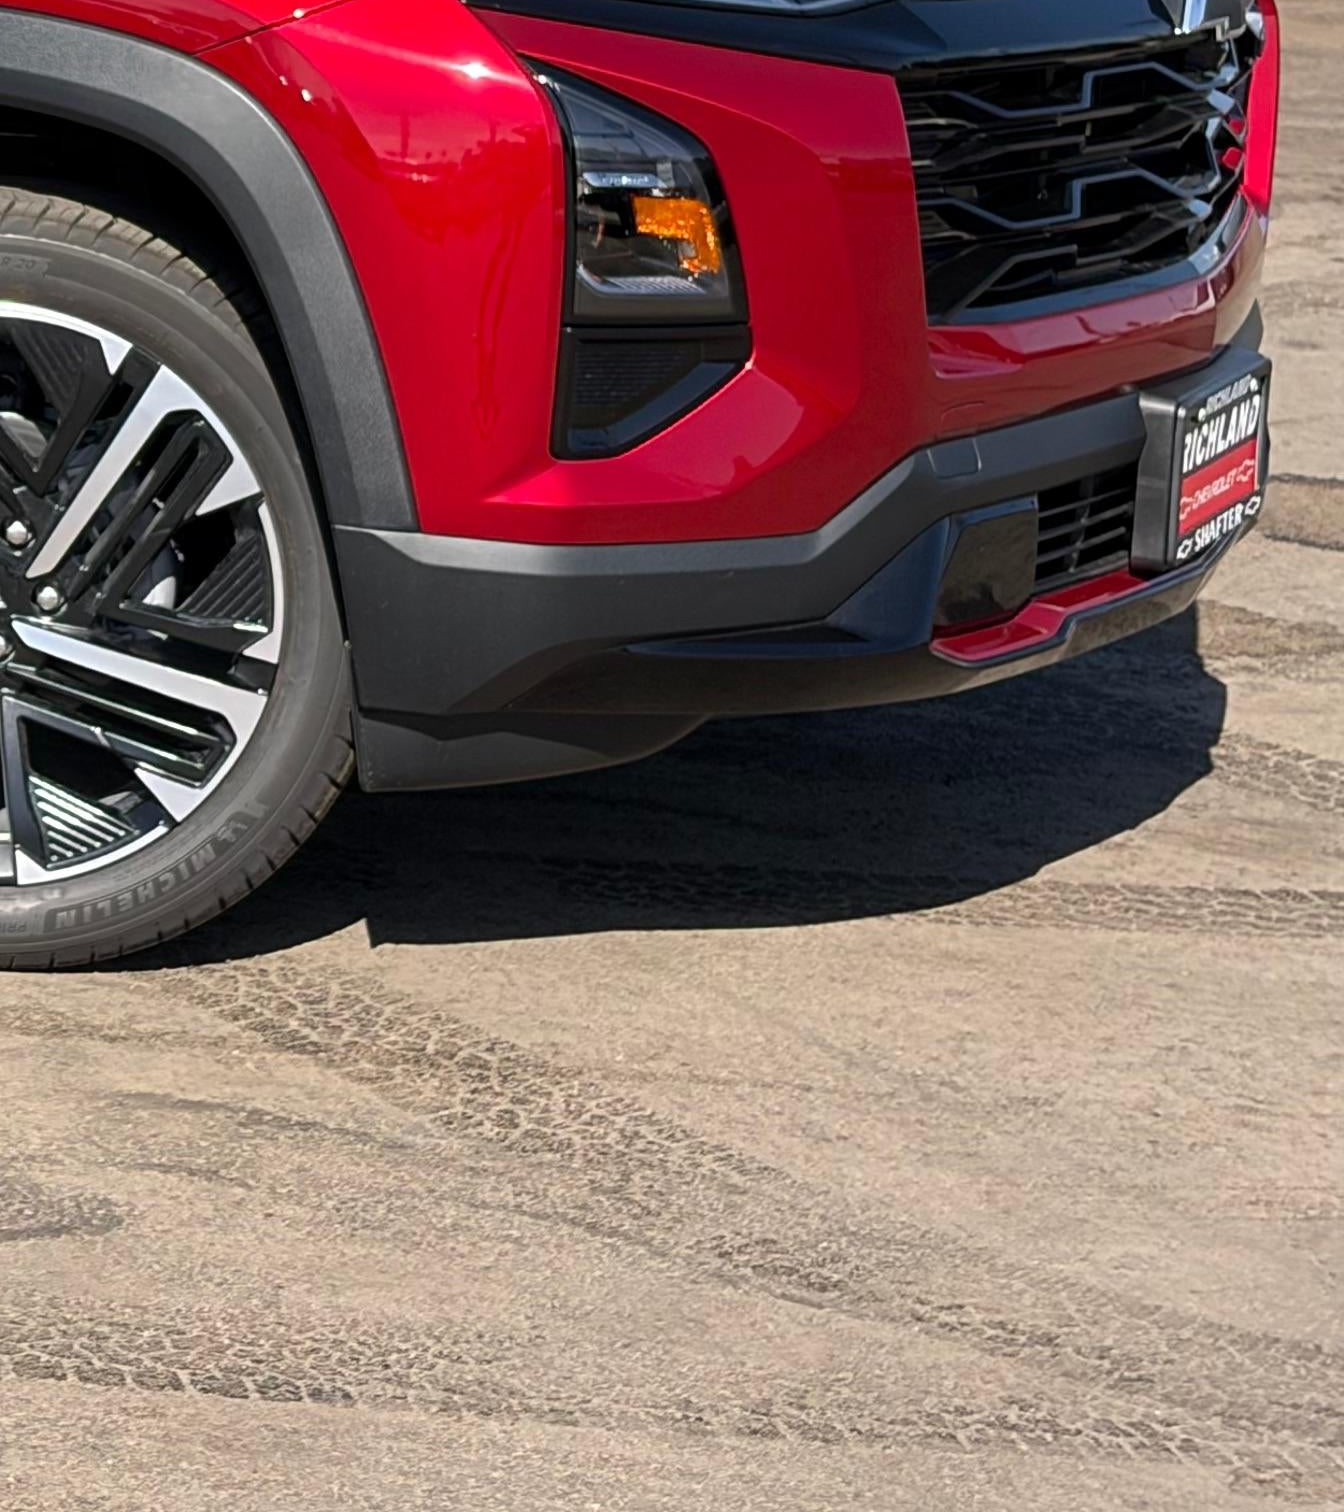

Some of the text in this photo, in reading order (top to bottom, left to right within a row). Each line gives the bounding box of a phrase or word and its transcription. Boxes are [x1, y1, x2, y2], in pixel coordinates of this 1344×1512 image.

[1182, 394, 1261, 474] RICHLAND
[1194, 503, 1244, 552] SHAFTER
[55, 841, 220, 930] MICHELIN
